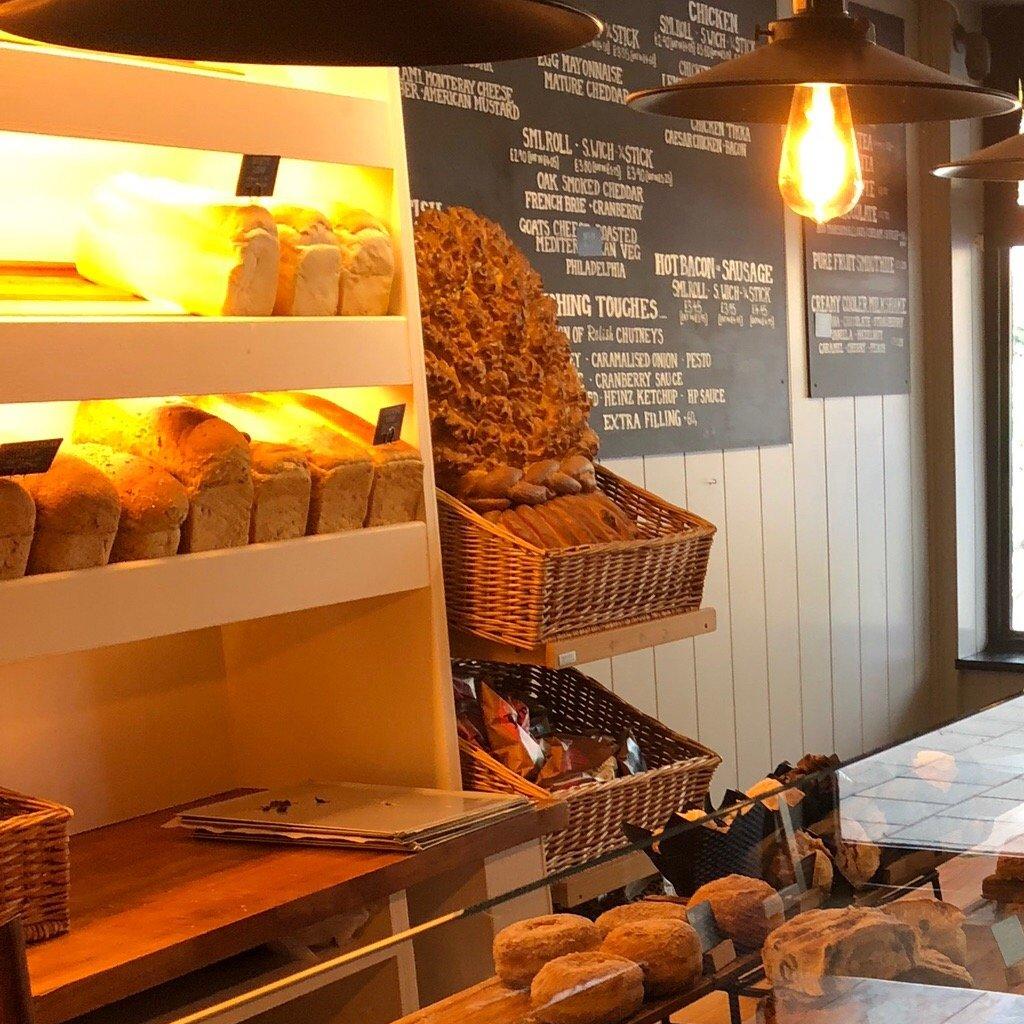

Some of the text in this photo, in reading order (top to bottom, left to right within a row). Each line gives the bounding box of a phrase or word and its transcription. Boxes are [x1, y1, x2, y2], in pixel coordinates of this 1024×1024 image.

[688, 0, 738, 34] CHICKEN
[561, 53, 623, 85] MAYONNAISE
[476, 81, 514, 103] CHEESE
[544, 70, 584, 97] MATURE
[423, 86, 472, 110] AMERICAN
[473, 95, 520, 120] MUSTARD
[537, 171, 644, 203] OAK SMOKED CHEDDAR
[524, 190, 643, 220] FRENCH BRIE CRANBERRY
[519, 217, 550, 236] GOATS
[619, 243, 641, 260] VEG
[812, 252, 833, 271] PURE
[565, 258, 626, 279] PHILADELPHIA
[654, 252, 774, 284] HOT BACON SAUSAGE
[572, 326, 584, 343] OF
[615, 327, 664, 344] CHUTNEYS
[591, 352, 650, 368] CARAMALISED
[652, 352, 678, 368] ONION
[686, 352, 712, 368] PESTO
[595, 372, 651, 389] CRANBERRY
[655, 372, 684, 387] SAUCE
[604, 390, 634, 407] HEINZ
[687, 389, 699, 404] HP
[700, 388, 725, 403] SAUCE
[603, 412, 641, 430] EXTRA
[644, 409, 682, 429] FILLING
